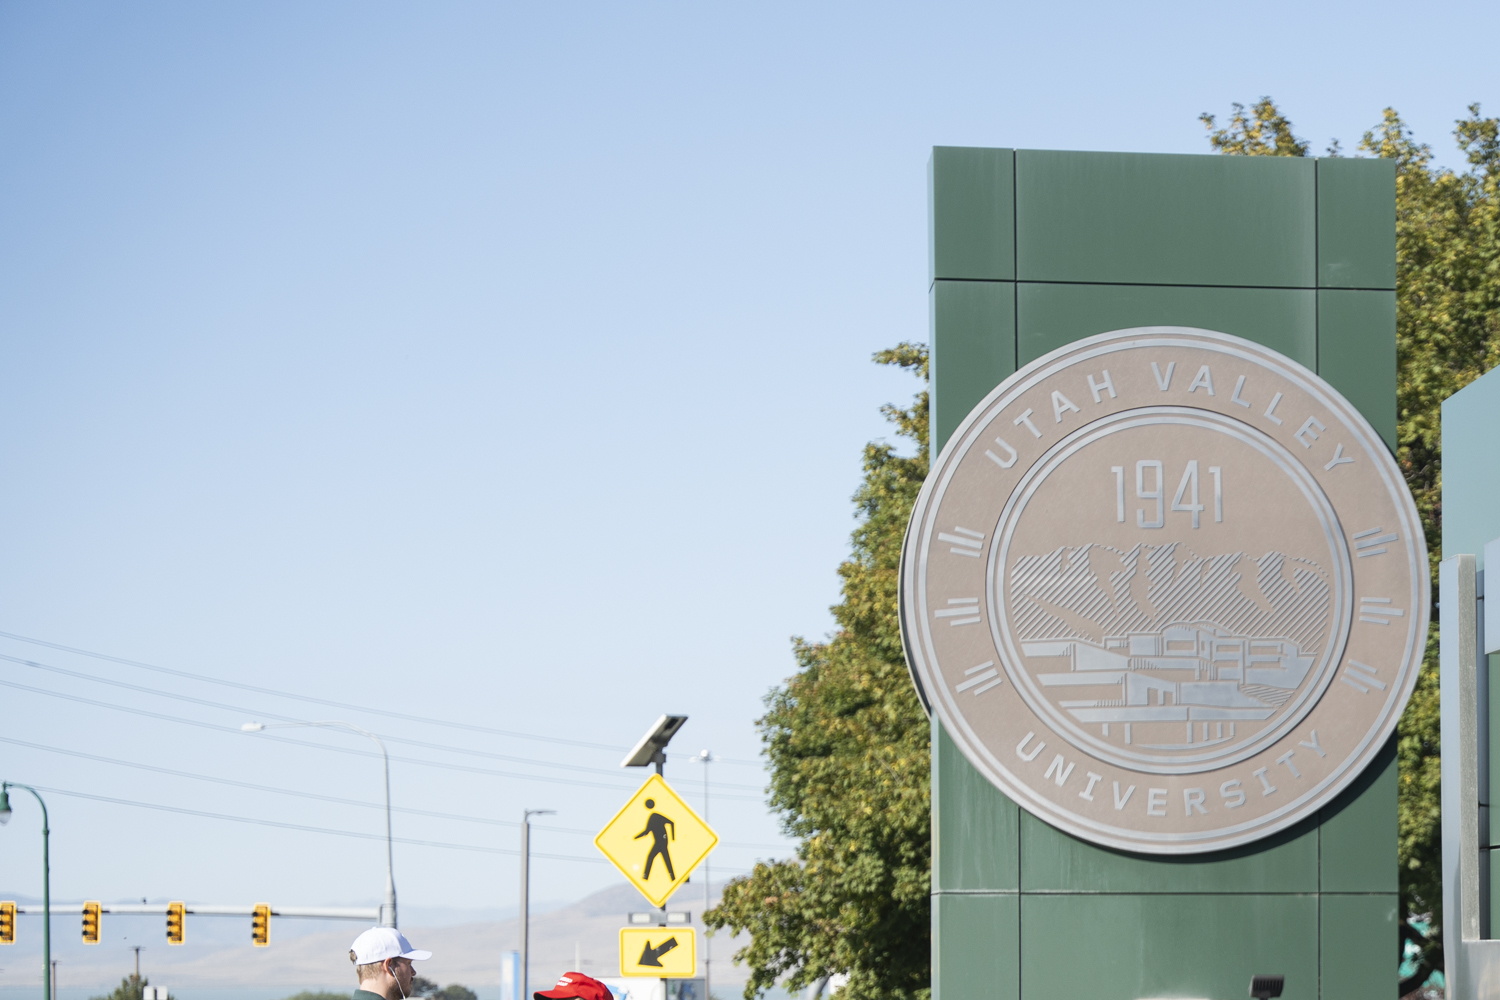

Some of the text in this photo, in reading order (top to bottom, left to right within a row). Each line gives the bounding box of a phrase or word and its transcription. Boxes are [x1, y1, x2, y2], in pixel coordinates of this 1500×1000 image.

[984, 361, 1355, 473] UTAH VALLEY
[1111, 459, 1223, 529] 1941
[1015, 728, 1327, 817] UNIVERSITY
